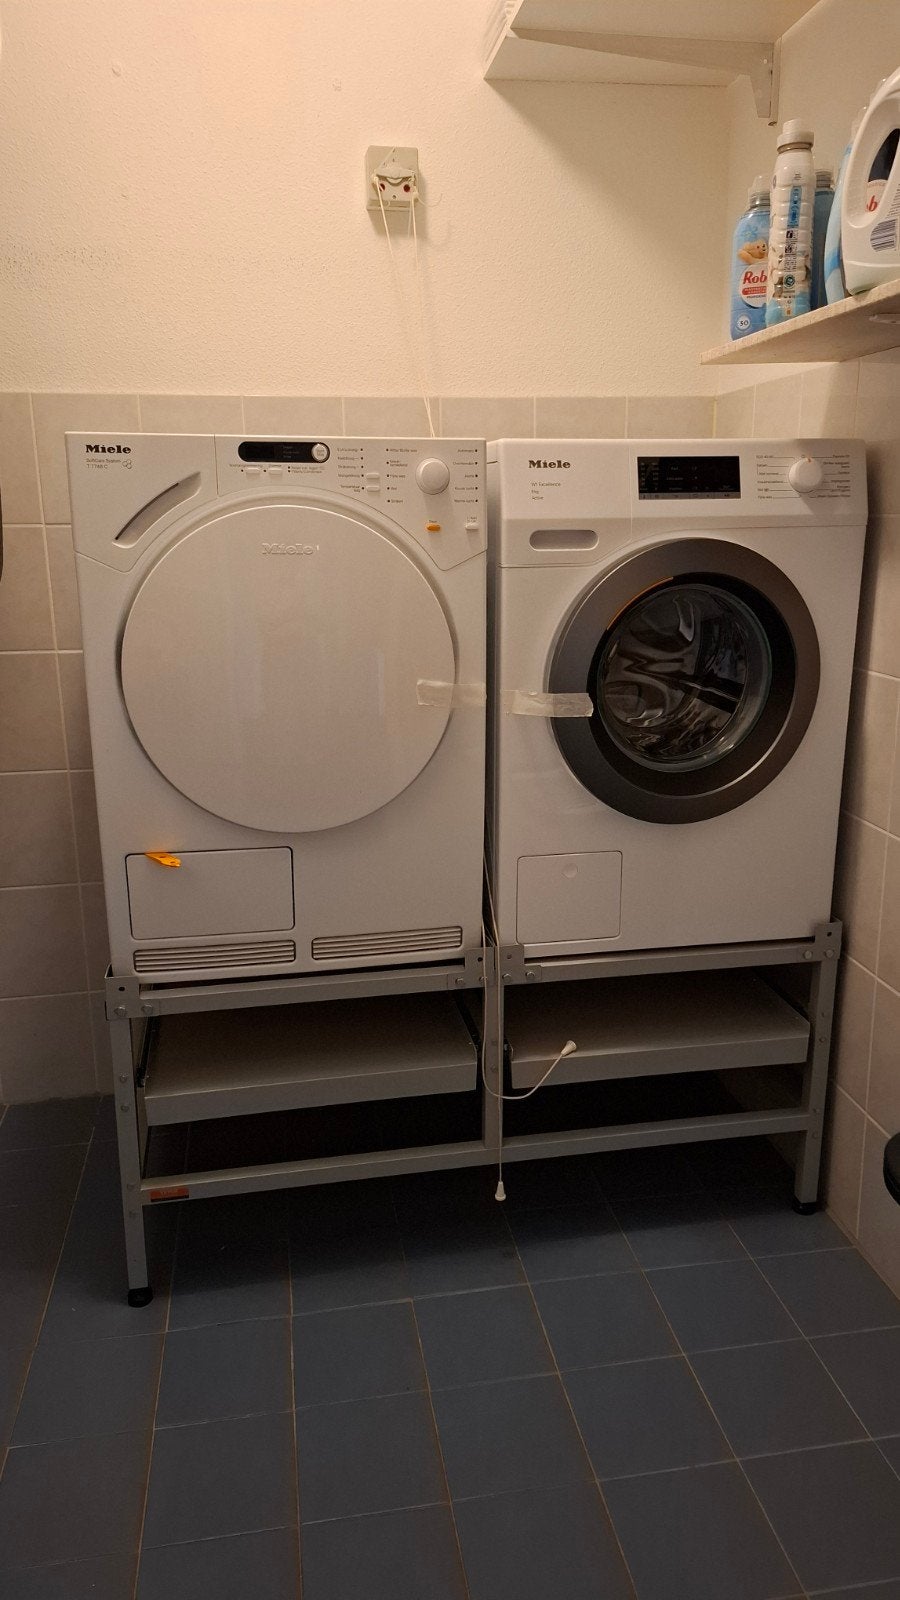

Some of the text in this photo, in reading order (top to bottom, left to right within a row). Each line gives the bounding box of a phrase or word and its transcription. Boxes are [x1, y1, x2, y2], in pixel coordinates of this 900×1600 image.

[743, 270, 768, 284] Rob
[86, 444, 131, 454] Miele
[528, 460, 571, 468] Miele
[261, 542, 314, 555] Miele
